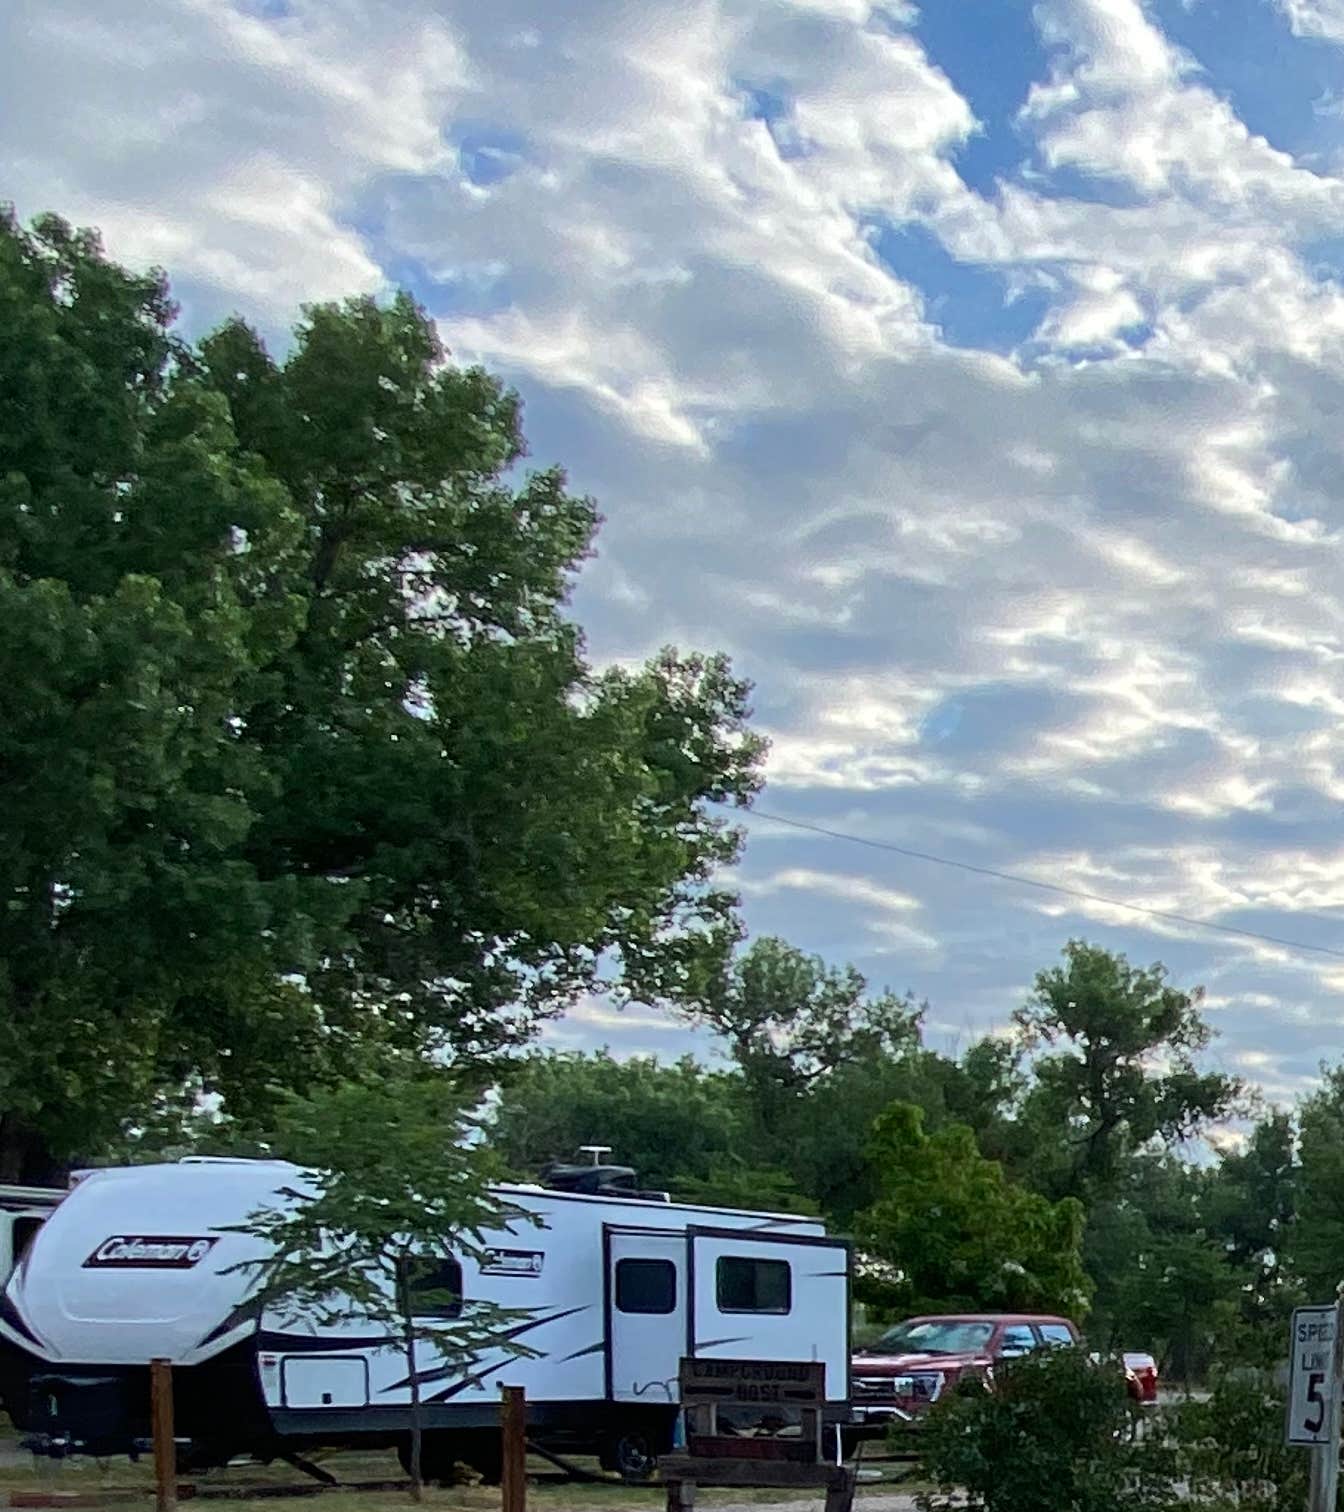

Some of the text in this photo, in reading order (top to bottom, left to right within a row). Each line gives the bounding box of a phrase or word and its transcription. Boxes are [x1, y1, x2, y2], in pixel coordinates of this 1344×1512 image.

[96, 1237, 189, 1261] Coleman
[735, 1383, 781, 1402] HOST
[1303, 1373, 1326, 1433] 5
